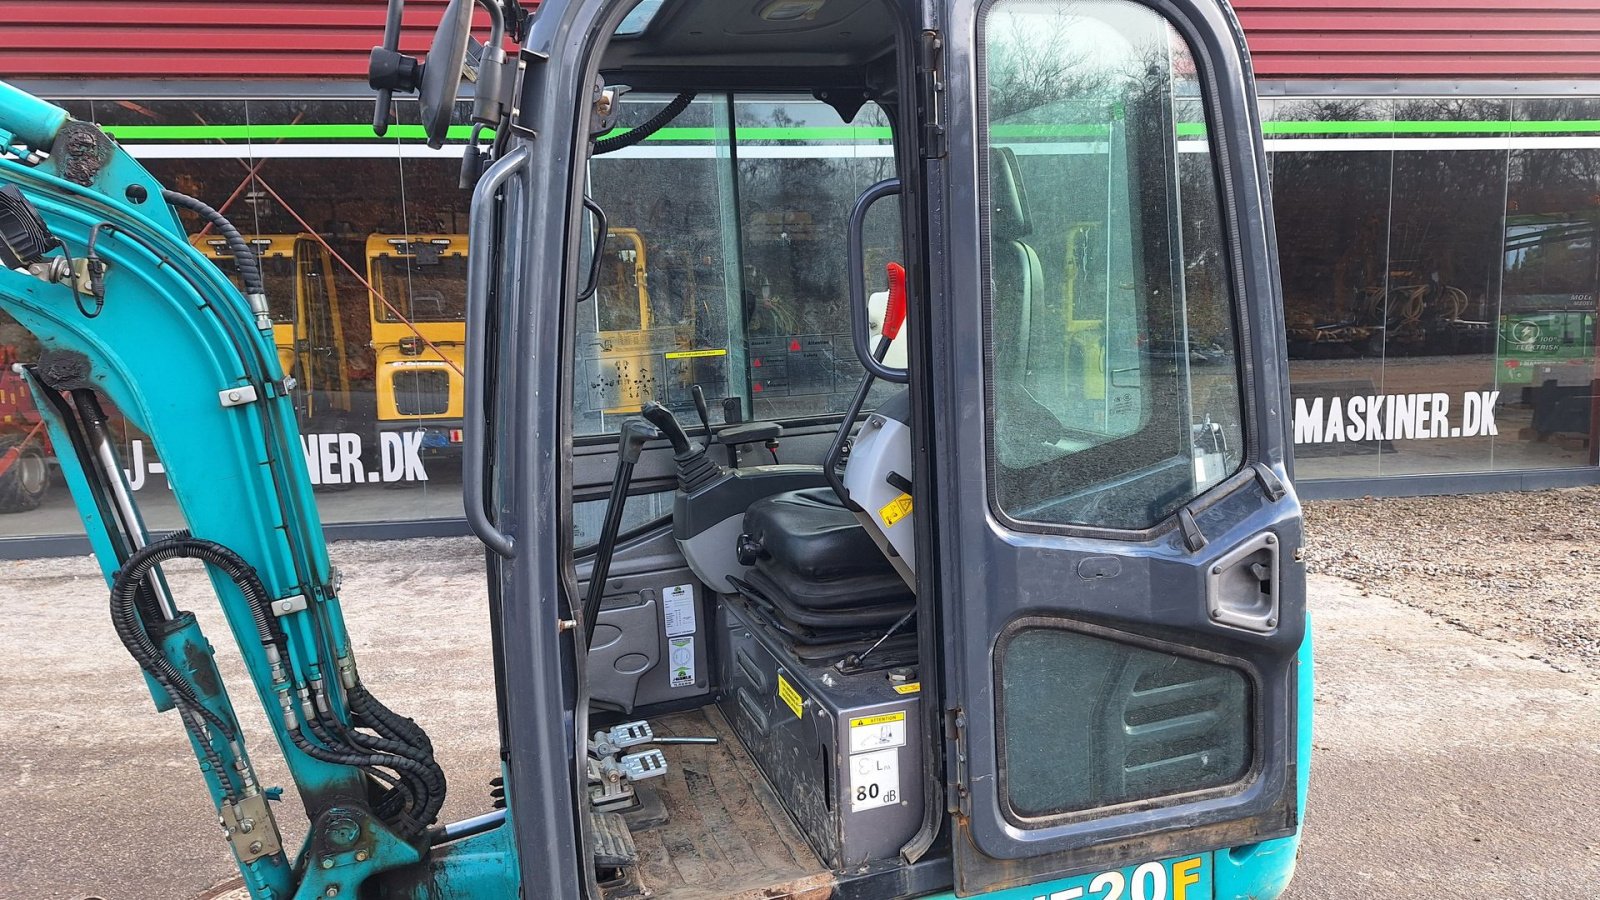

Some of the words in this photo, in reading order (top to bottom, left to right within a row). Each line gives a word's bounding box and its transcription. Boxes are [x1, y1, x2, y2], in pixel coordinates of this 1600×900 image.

[1291, 391, 1500, 444] MASKINER.DK
[870, 715, 897, 723] ATTENTION
[857, 783, 879, 801] 80
[883, 789, 897, 803] dB
